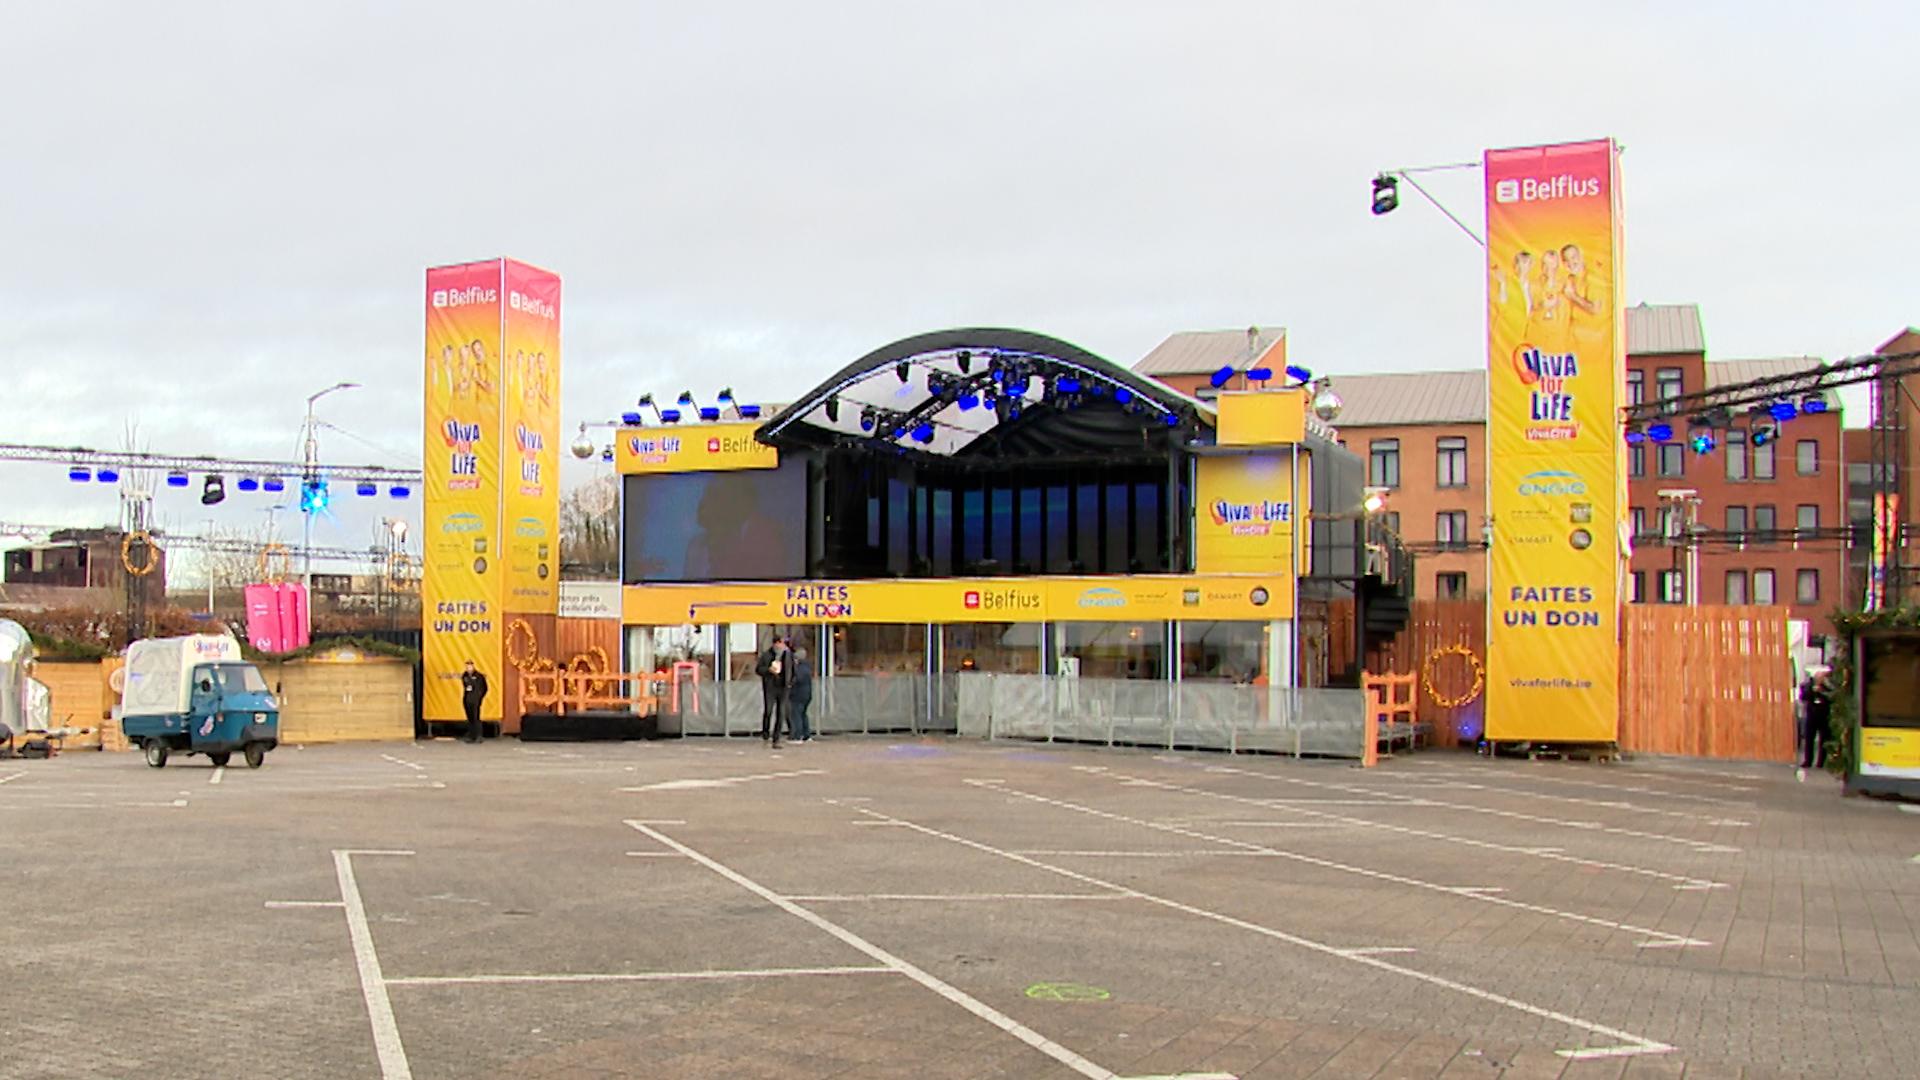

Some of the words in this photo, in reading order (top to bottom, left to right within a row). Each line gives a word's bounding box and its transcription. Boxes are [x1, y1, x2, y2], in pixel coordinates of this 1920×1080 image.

[1522, 175, 1599, 200] Belfius
[448, 286, 496, 307] Belfius
[521, 295, 555, 319] Belfius
[787, 587, 848, 600] FAITES
[984, 590, 1039, 609] Belfius
[1511, 586, 1592, 602] FAITES
[437, 602, 487, 614] FAITES
[784, 604, 808, 617] UN
[815, 604, 851, 618] DON
[435, 621, 454, 632] UN
[458, 621, 491, 632] DON
[1504, 610, 1537, 627] UN
[1545, 611, 1599, 627] DON
